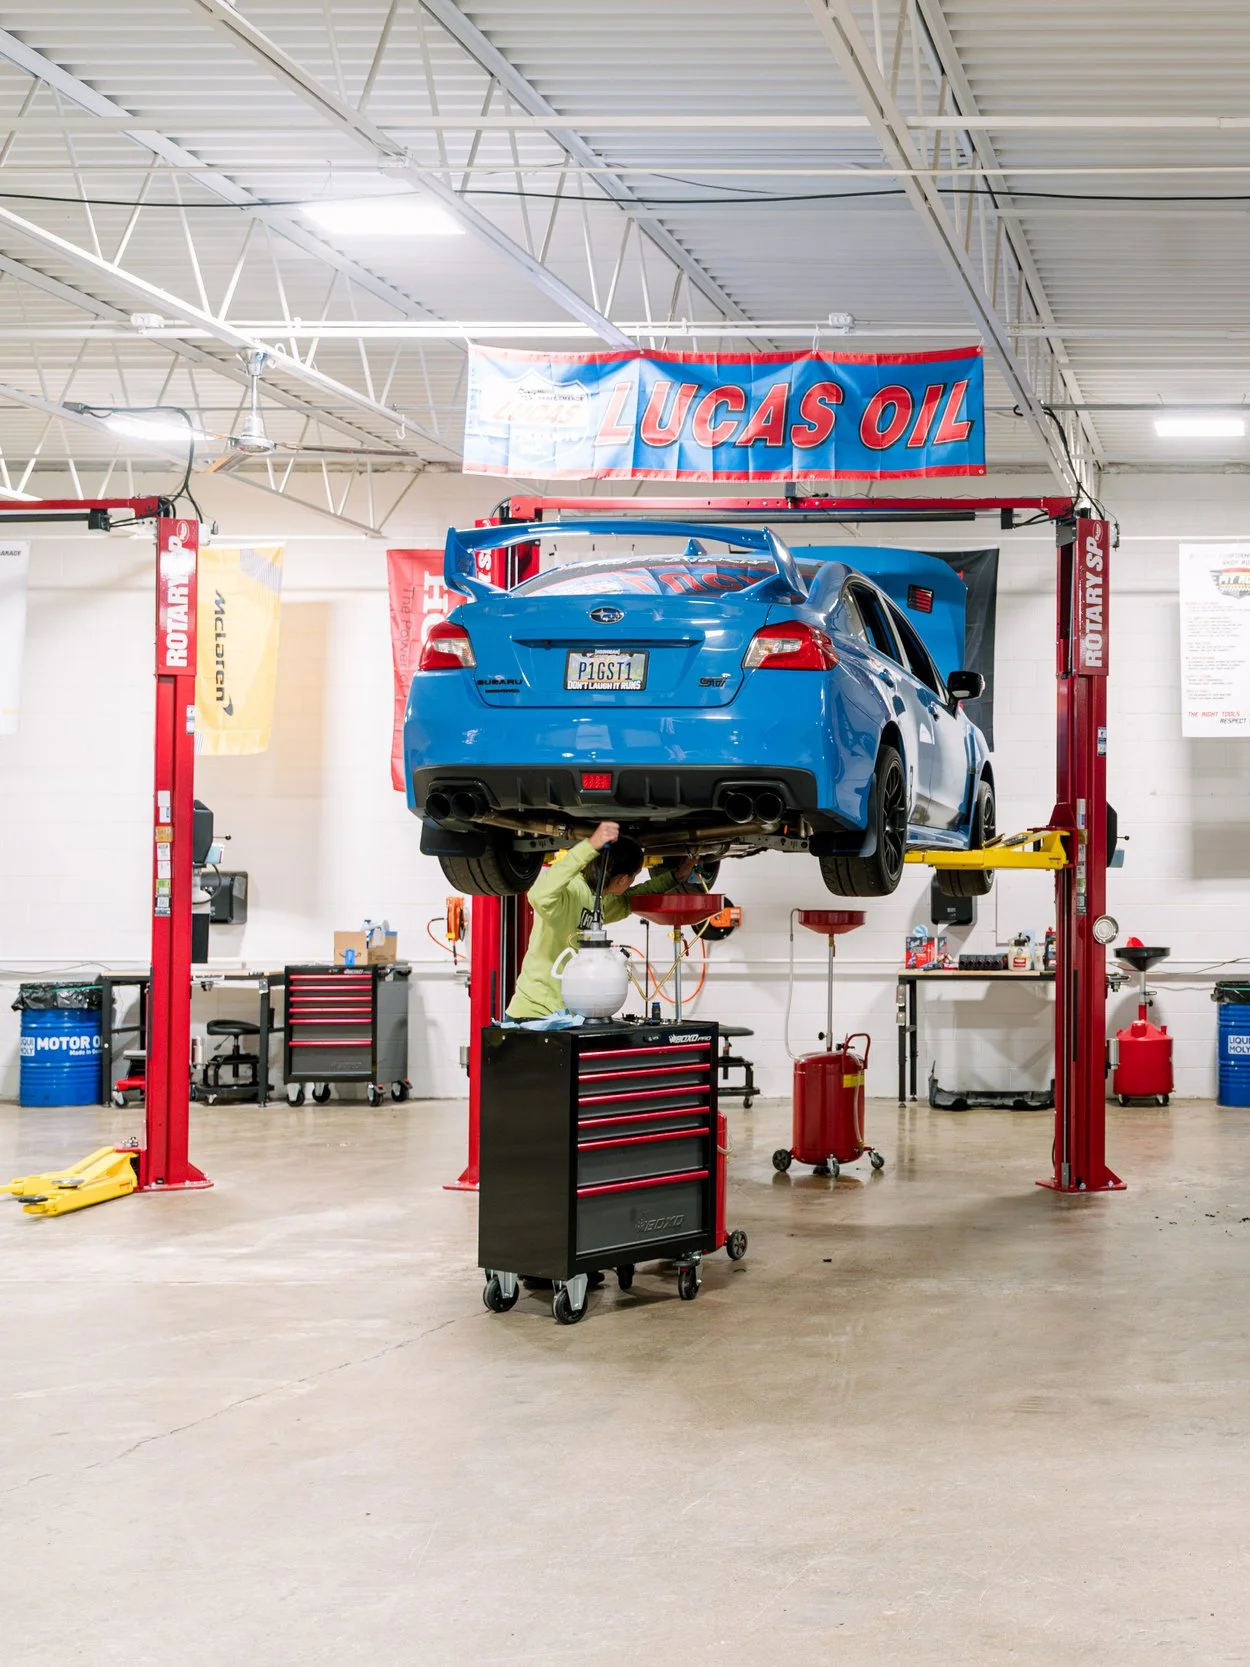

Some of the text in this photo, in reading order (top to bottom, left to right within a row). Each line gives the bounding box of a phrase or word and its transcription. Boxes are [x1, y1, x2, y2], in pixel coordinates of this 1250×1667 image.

[595, 377, 976, 450] LUCAS OIL
[1085, 535, 1103, 667] ROTARY SP
[578, 661, 632, 681] P1GST1
[567, 680, 641, 690] DON'T LAUGH IT RUNS
[37, 1036, 90, 1050] MOTOR
[1229, 1036, 1250, 1044] LIQUI
